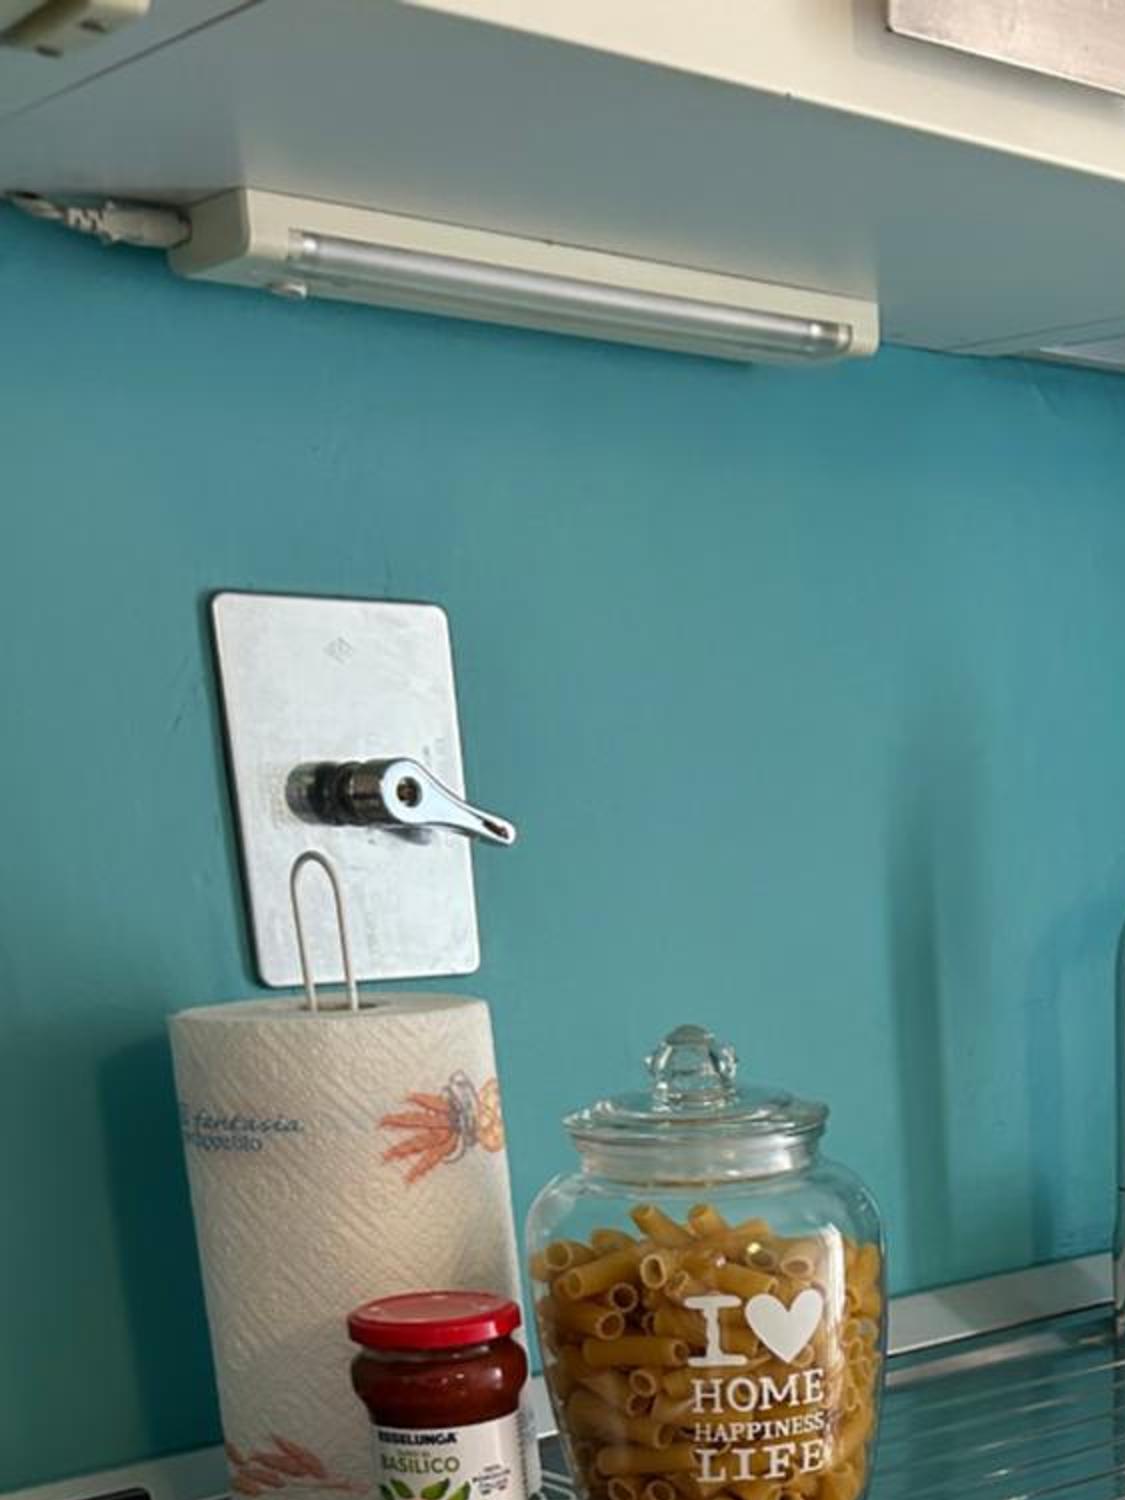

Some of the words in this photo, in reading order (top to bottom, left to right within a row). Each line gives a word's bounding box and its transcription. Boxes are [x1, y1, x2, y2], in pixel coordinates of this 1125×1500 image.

[684, 1295, 748, 1367] I
[690, 1368, 824, 1414] HOME
[694, 1411, 826, 1443] HAPPINESS
[695, 1439, 825, 1483] LIFE
